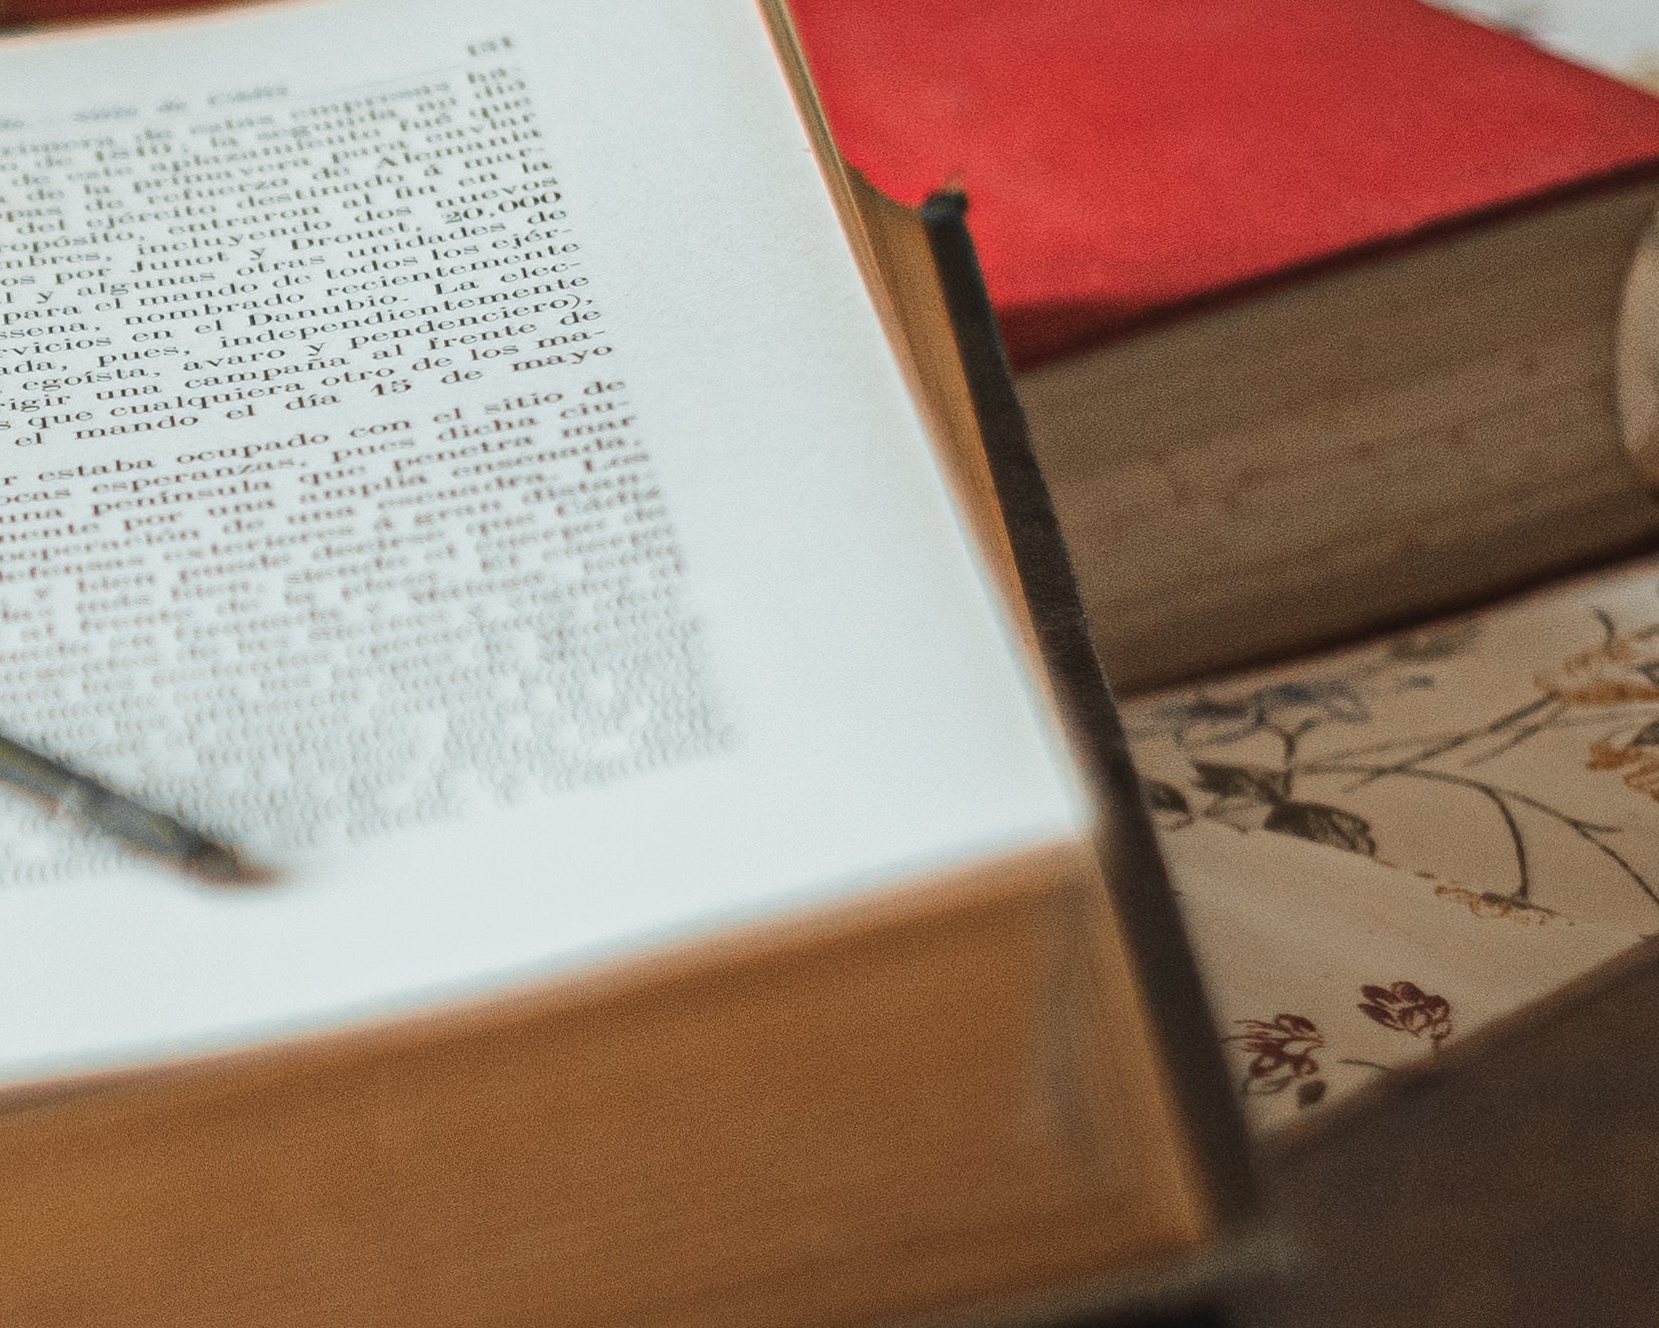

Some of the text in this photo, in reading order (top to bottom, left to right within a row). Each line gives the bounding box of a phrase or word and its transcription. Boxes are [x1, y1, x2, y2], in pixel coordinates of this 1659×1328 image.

[3, 305, 79, 326] para
[94, 297, 121, 311] el
[139, 282, 259, 306] mando
[272, 273, 311, 288] de
[325, 258, 418, 279] todos
[431, 244, 480, 261] los
[98, 345, 191, 368] pues,
[220, 276, 589, 348] independientemente
[124, 292, 305, 326] nombrado
[326, 242, 580, 297] recientemente
[131, 329, 172, 342] en
[194, 318, 223, 334] el
[434, 280, 479, 295] La
[14, 431, 43, 446] el
[75, 414, 199, 440] mando
[225, 403, 255, 420] el
[284, 393, 340, 410] día
[373, 378, 412, 396] 15
[440, 369, 483, 384] de
[511, 345, 613, 372] mayo
[27, 411, 93, 430] que
[109, 382, 305, 417] cualquiera
[320, 368, 395, 386] otro
[411, 356, 451, 371] de
[470, 344, 520, 361] los
[95, 384, 162, 400] una
[184, 356, 350, 389] campaña
[372, 343, 403, 360] al
[428, 323, 537, 350] frente
[559, 310, 602, 326] de
[182, 349, 286, 371] avaro
[37, 458, 155, 481] estaba
[176, 432, 330, 464] ocupado
[348, 419, 412, 438] con
[432, 406, 462, 423] el
[484, 392, 564, 412] sitio
[583, 380, 626, 396] de
